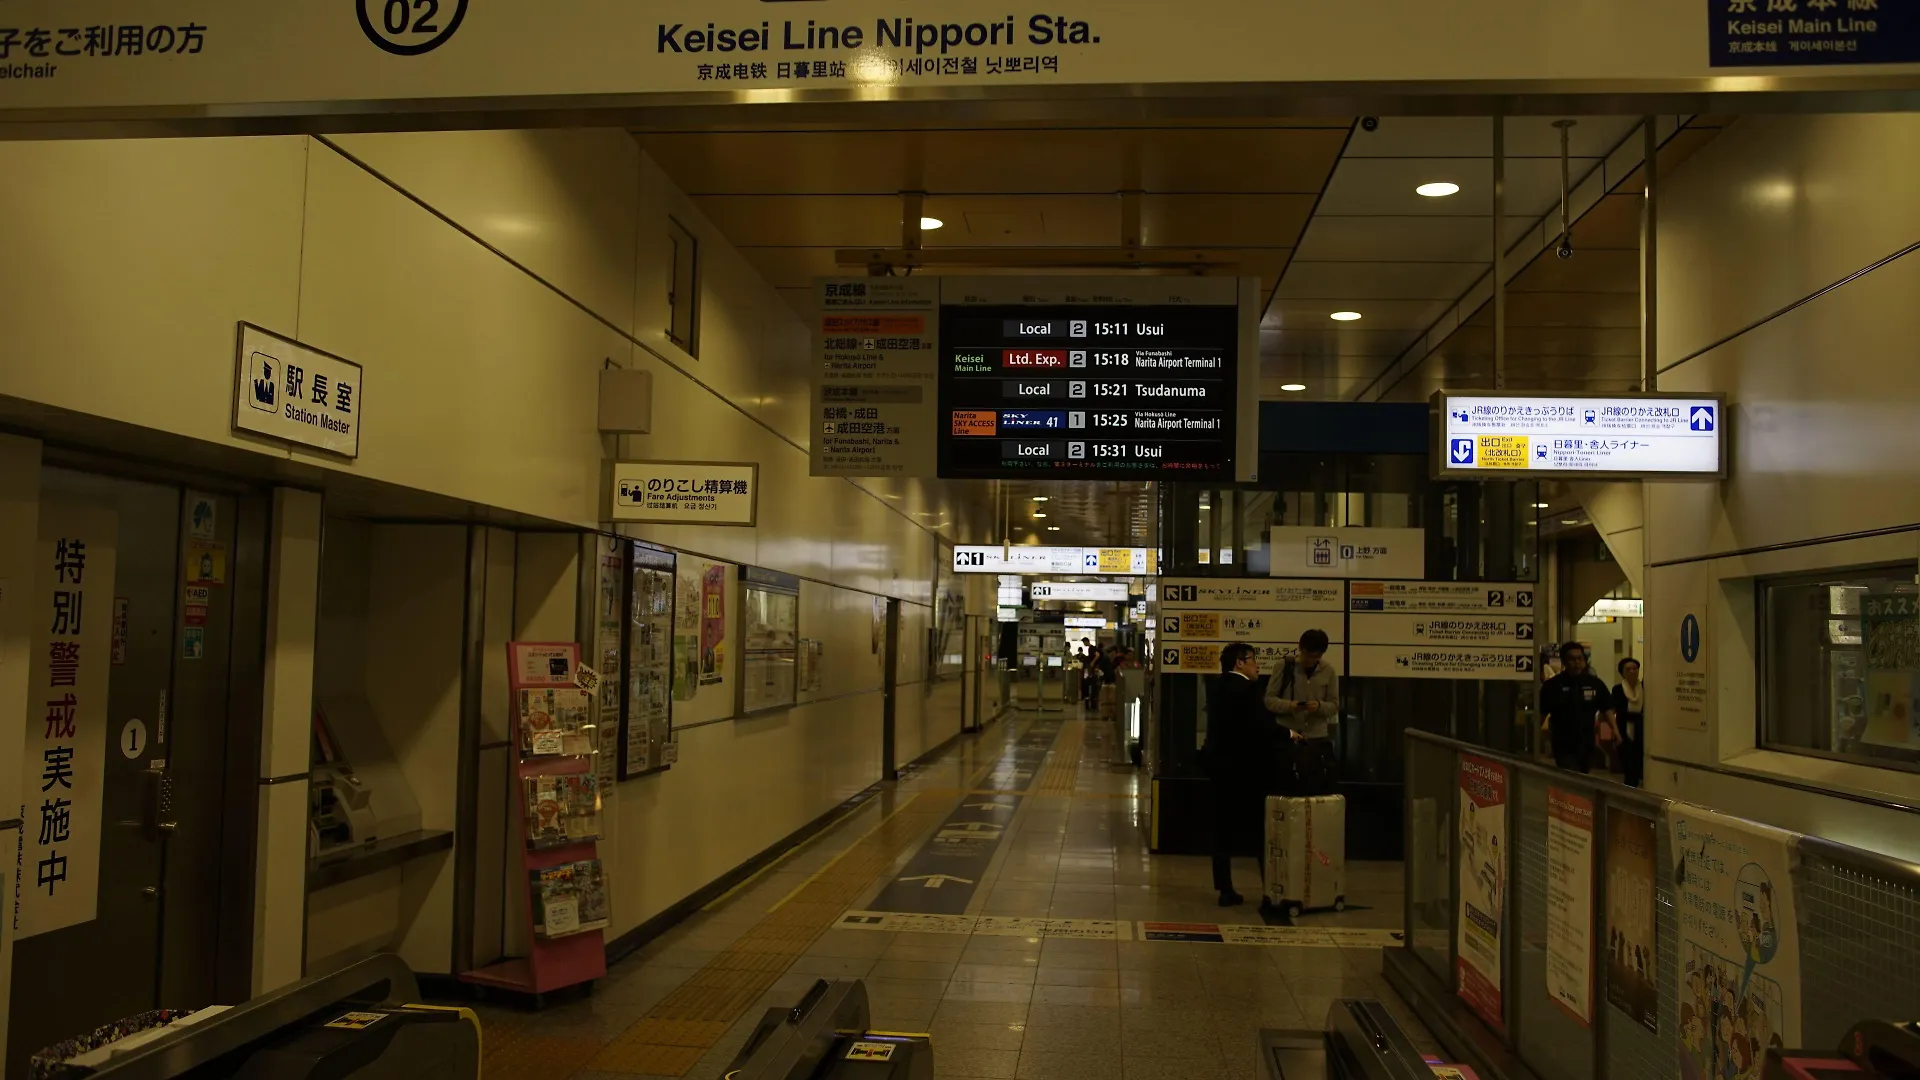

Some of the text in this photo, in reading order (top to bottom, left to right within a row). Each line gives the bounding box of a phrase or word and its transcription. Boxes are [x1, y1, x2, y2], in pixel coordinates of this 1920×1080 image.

[383, 0, 439, 34] 02
[1727, 18, 1878, 35] Keisei Main Line
[0, 22, 207, 58] 子をご利用の方
[657, 14, 1100, 54] Keisei Line Nippori Sta.
[697, 62, 767, 80] 京成电铁
[777, 60, 847, 78] 日暮里站
[985, 55, 1058, 74] 닛뽀리역
[1019, 322, 1164, 336] Local 2 15:11 Usui
[955, 354, 984, 363] Keisei
[1009, 353, 1129, 367] Ltd. Exp. 2 15:18
[1135, 356, 1221, 369] Narita Airport Terminal 1
[852, 362, 877, 370] Airport
[954, 364, 992, 372] Main Line
[286, 364, 352, 413] 駅長室
[1019, 383, 1206, 397] Local 2 15:21 Tsudanuma
[1471, 405, 1574, 416] JR線のりかえきっぷうりば
[1601, 406, 1680, 417] JR線のりかえ改札口
[285, 403, 350, 434] Station Master
[1046, 416, 1058, 428] 41
[1073, 414, 1128, 427] 1 15:25
[1134, 418, 1220, 430] Narita Airport Terminal 1
[1481, 437, 1500, 447] 出口
[1554, 439, 1650, 450] 日暮里・舎人ライナー
[851, 446, 876, 454] Airport
[1018, 443, 1162, 457] Local 2 15:31 Usui
[647, 478, 748, 495] のりこし精算機
[647, 492, 715, 502] Fare Adjustments
[193, 588, 208, 598] AED
[1490, 592, 1501, 606] 2
[1184, 614, 1199, 623] 出口
[1429, 621, 1506, 631] JR線のりかえ改札口
[1184, 646, 1198, 655] 出口
[37, 537, 86, 897] 特別警戒実施中
[129, 728, 138, 751] 1
